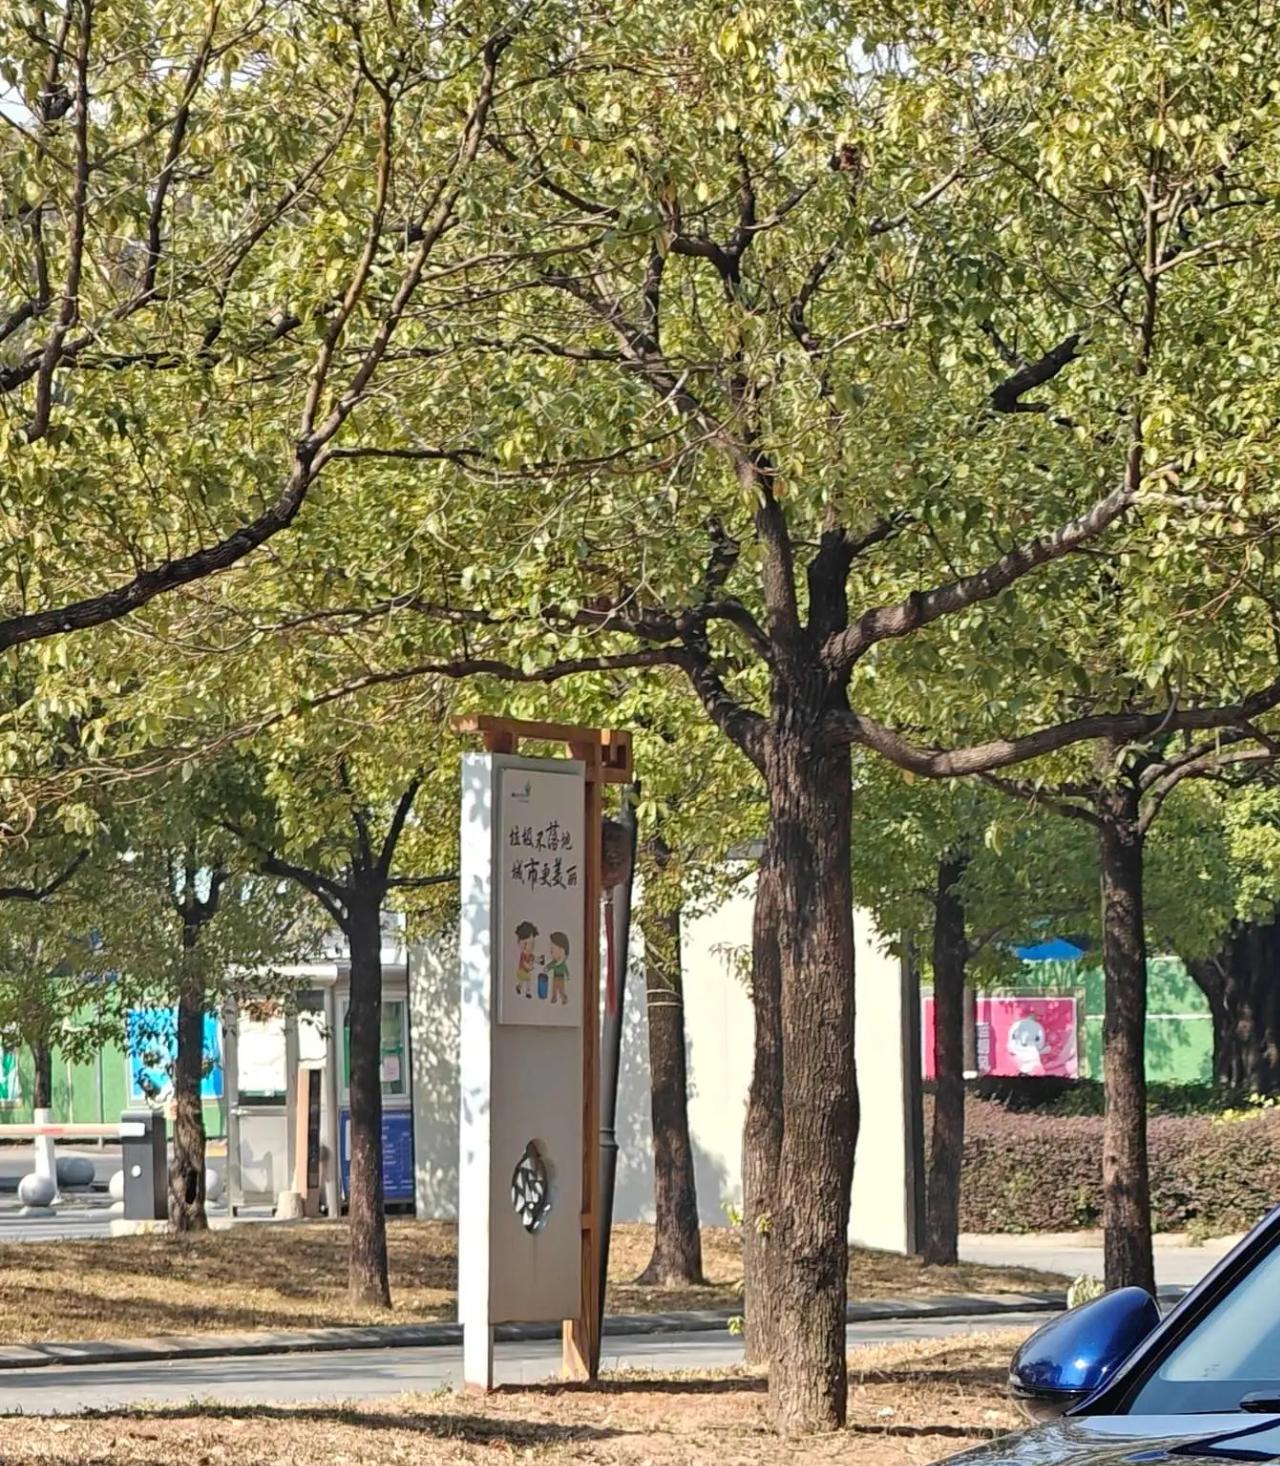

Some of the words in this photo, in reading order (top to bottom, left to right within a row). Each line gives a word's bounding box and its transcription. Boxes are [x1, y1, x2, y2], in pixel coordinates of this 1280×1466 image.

[509, 819, 574, 852] 垃圾不落地
[511, 856, 579, 892] 城市更美丽
